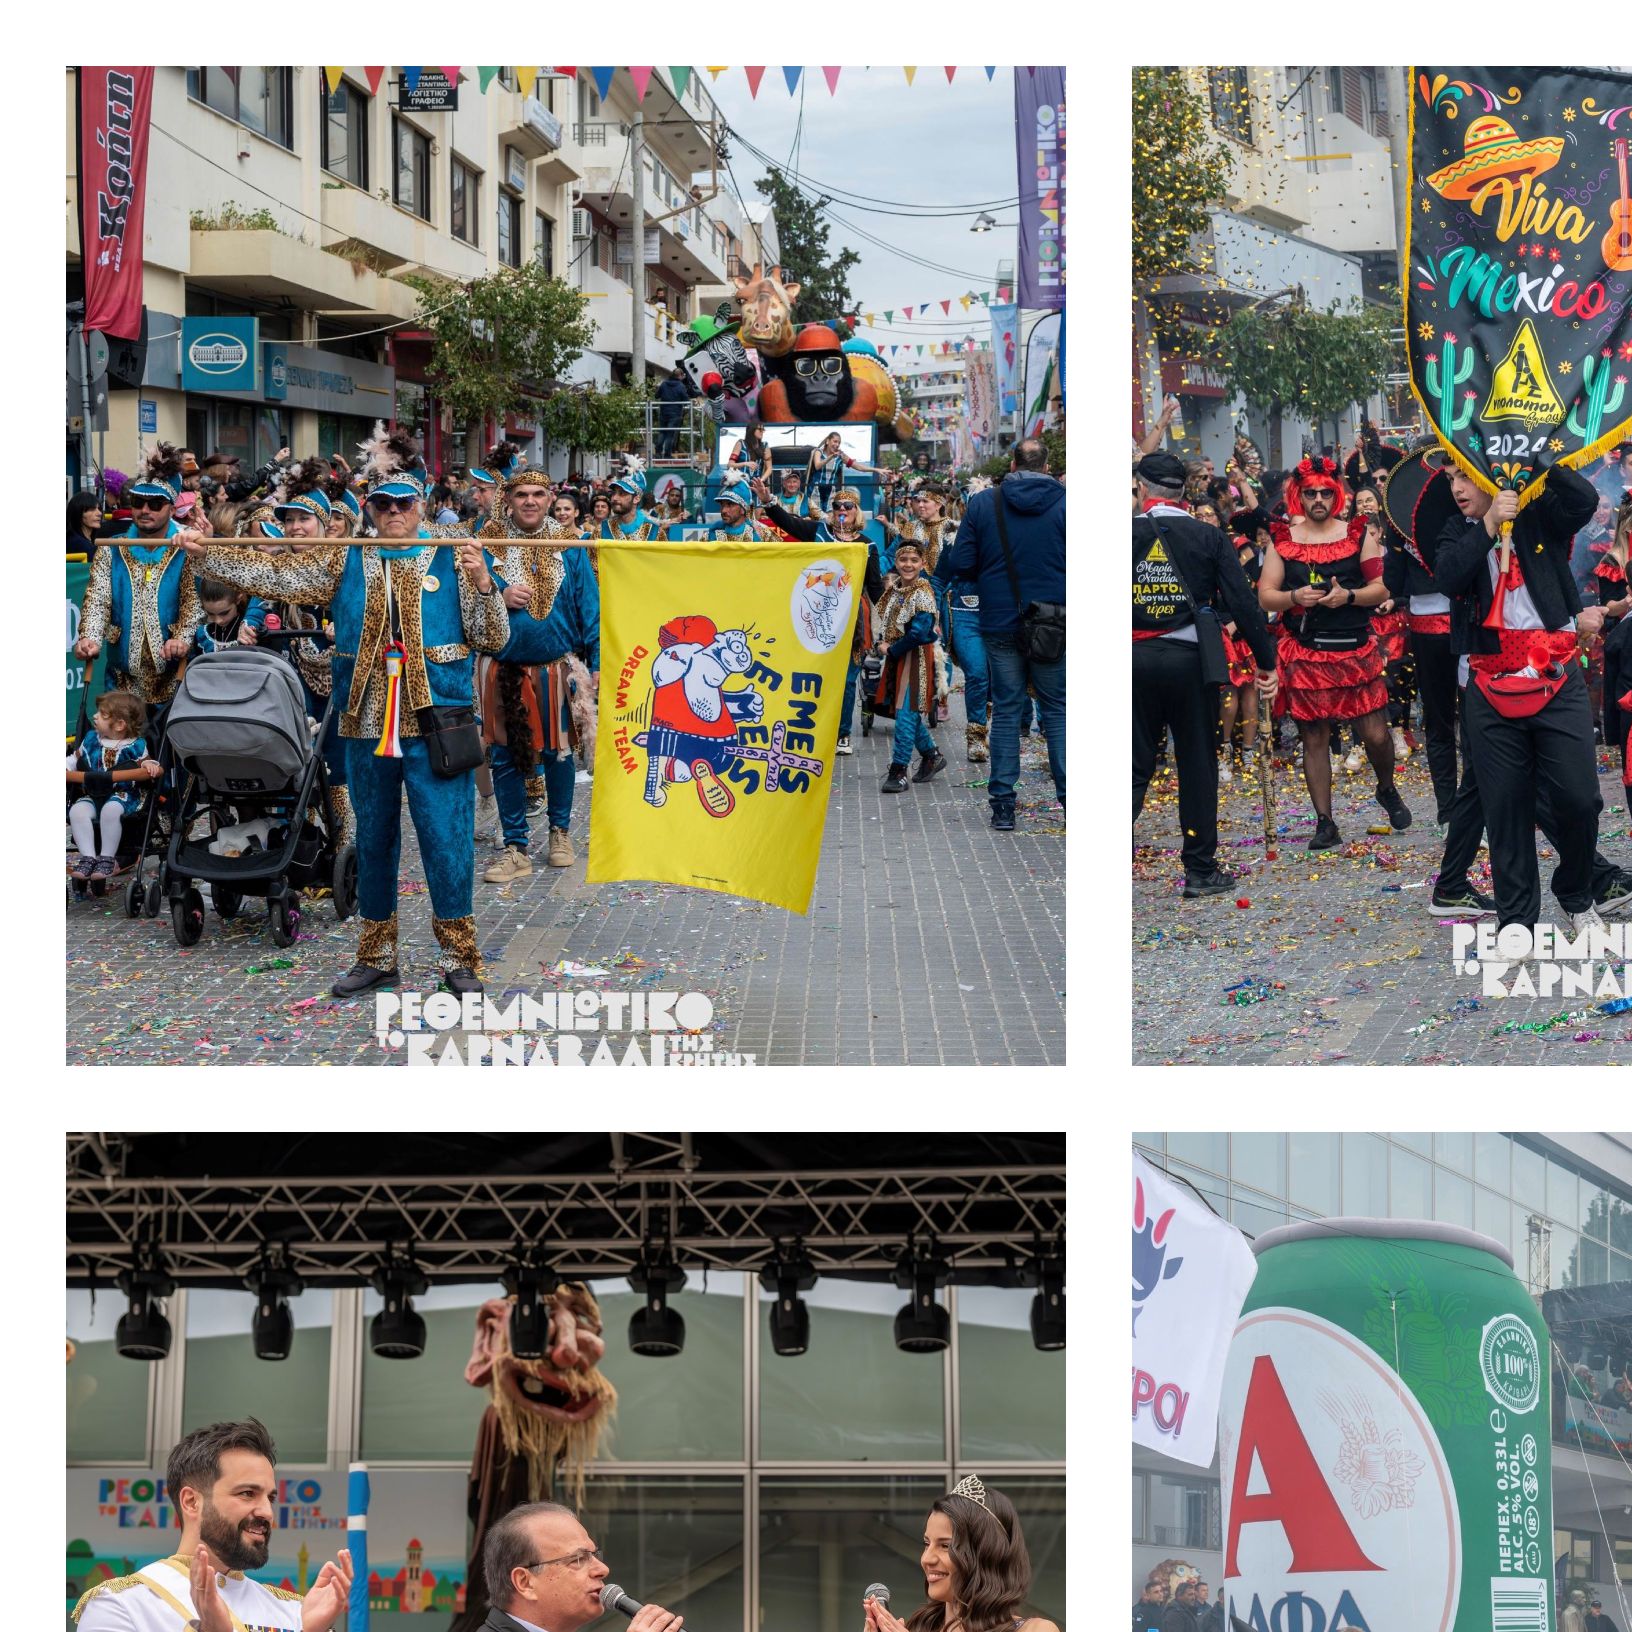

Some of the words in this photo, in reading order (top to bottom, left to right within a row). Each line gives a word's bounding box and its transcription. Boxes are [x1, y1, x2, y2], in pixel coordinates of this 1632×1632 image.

[1470, 173, 1596, 244] Viva
[1439, 246, 1610, 320] Mexico
[1486, 433, 1548, 458] 2024
[1136, 560, 1173, 575] Μαρία
[615, 645, 649, 709] DREAM
[613, 726, 639, 775] TEAM
[1509, 1443, 1521, 1490] VOL.
[1511, 1493, 1523, 1525] 5%
[1513, 1530, 1525, 1573] ALC.
